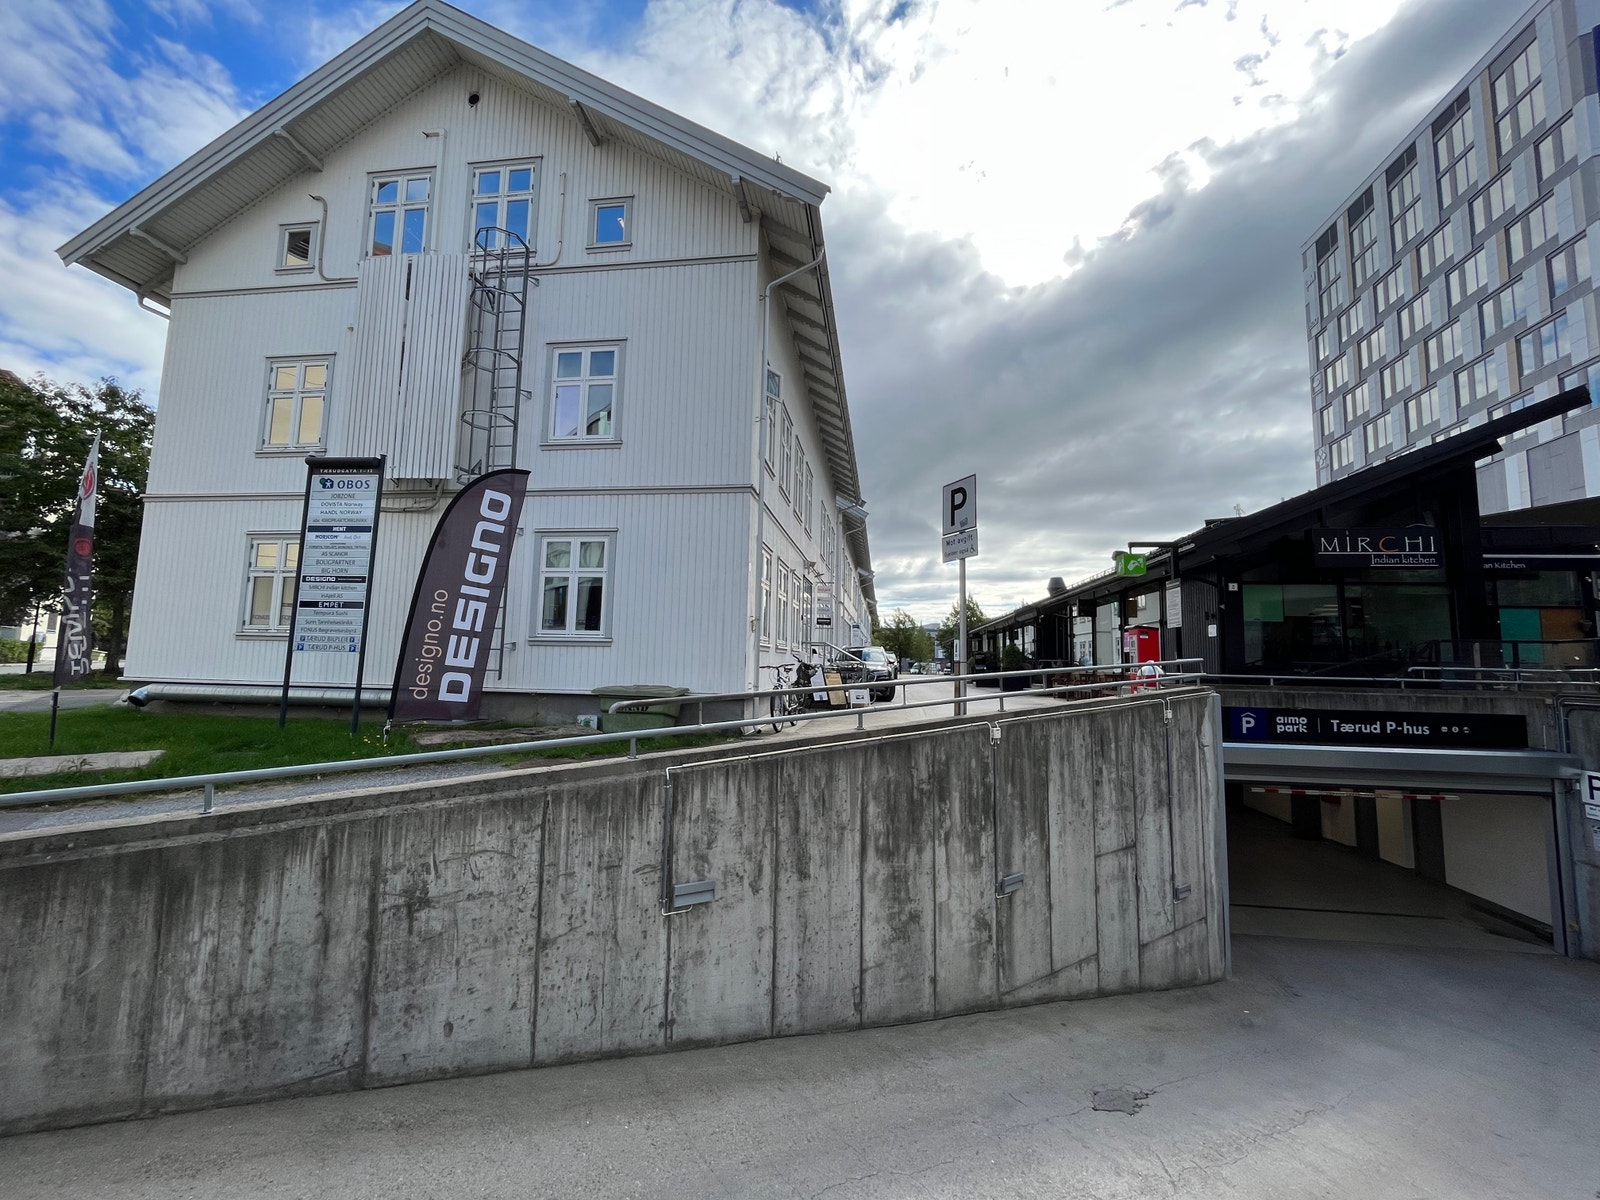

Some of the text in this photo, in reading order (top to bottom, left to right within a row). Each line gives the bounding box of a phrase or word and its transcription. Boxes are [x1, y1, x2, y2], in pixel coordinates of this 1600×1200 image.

[337, 480, 370, 489] OBOS
[950, 486, 967, 527] P
[945, 534, 973, 547] Mot avgift
[1371, 554, 1436, 565] Indian kitchen
[408, 589, 449, 700] designo.no
[1241, 716, 1256, 734] P
[1275, 716, 1308, 725] aimo
[1330, 719, 1430, 735] Tærud P-hus
[1276, 723, 1308, 734] park
